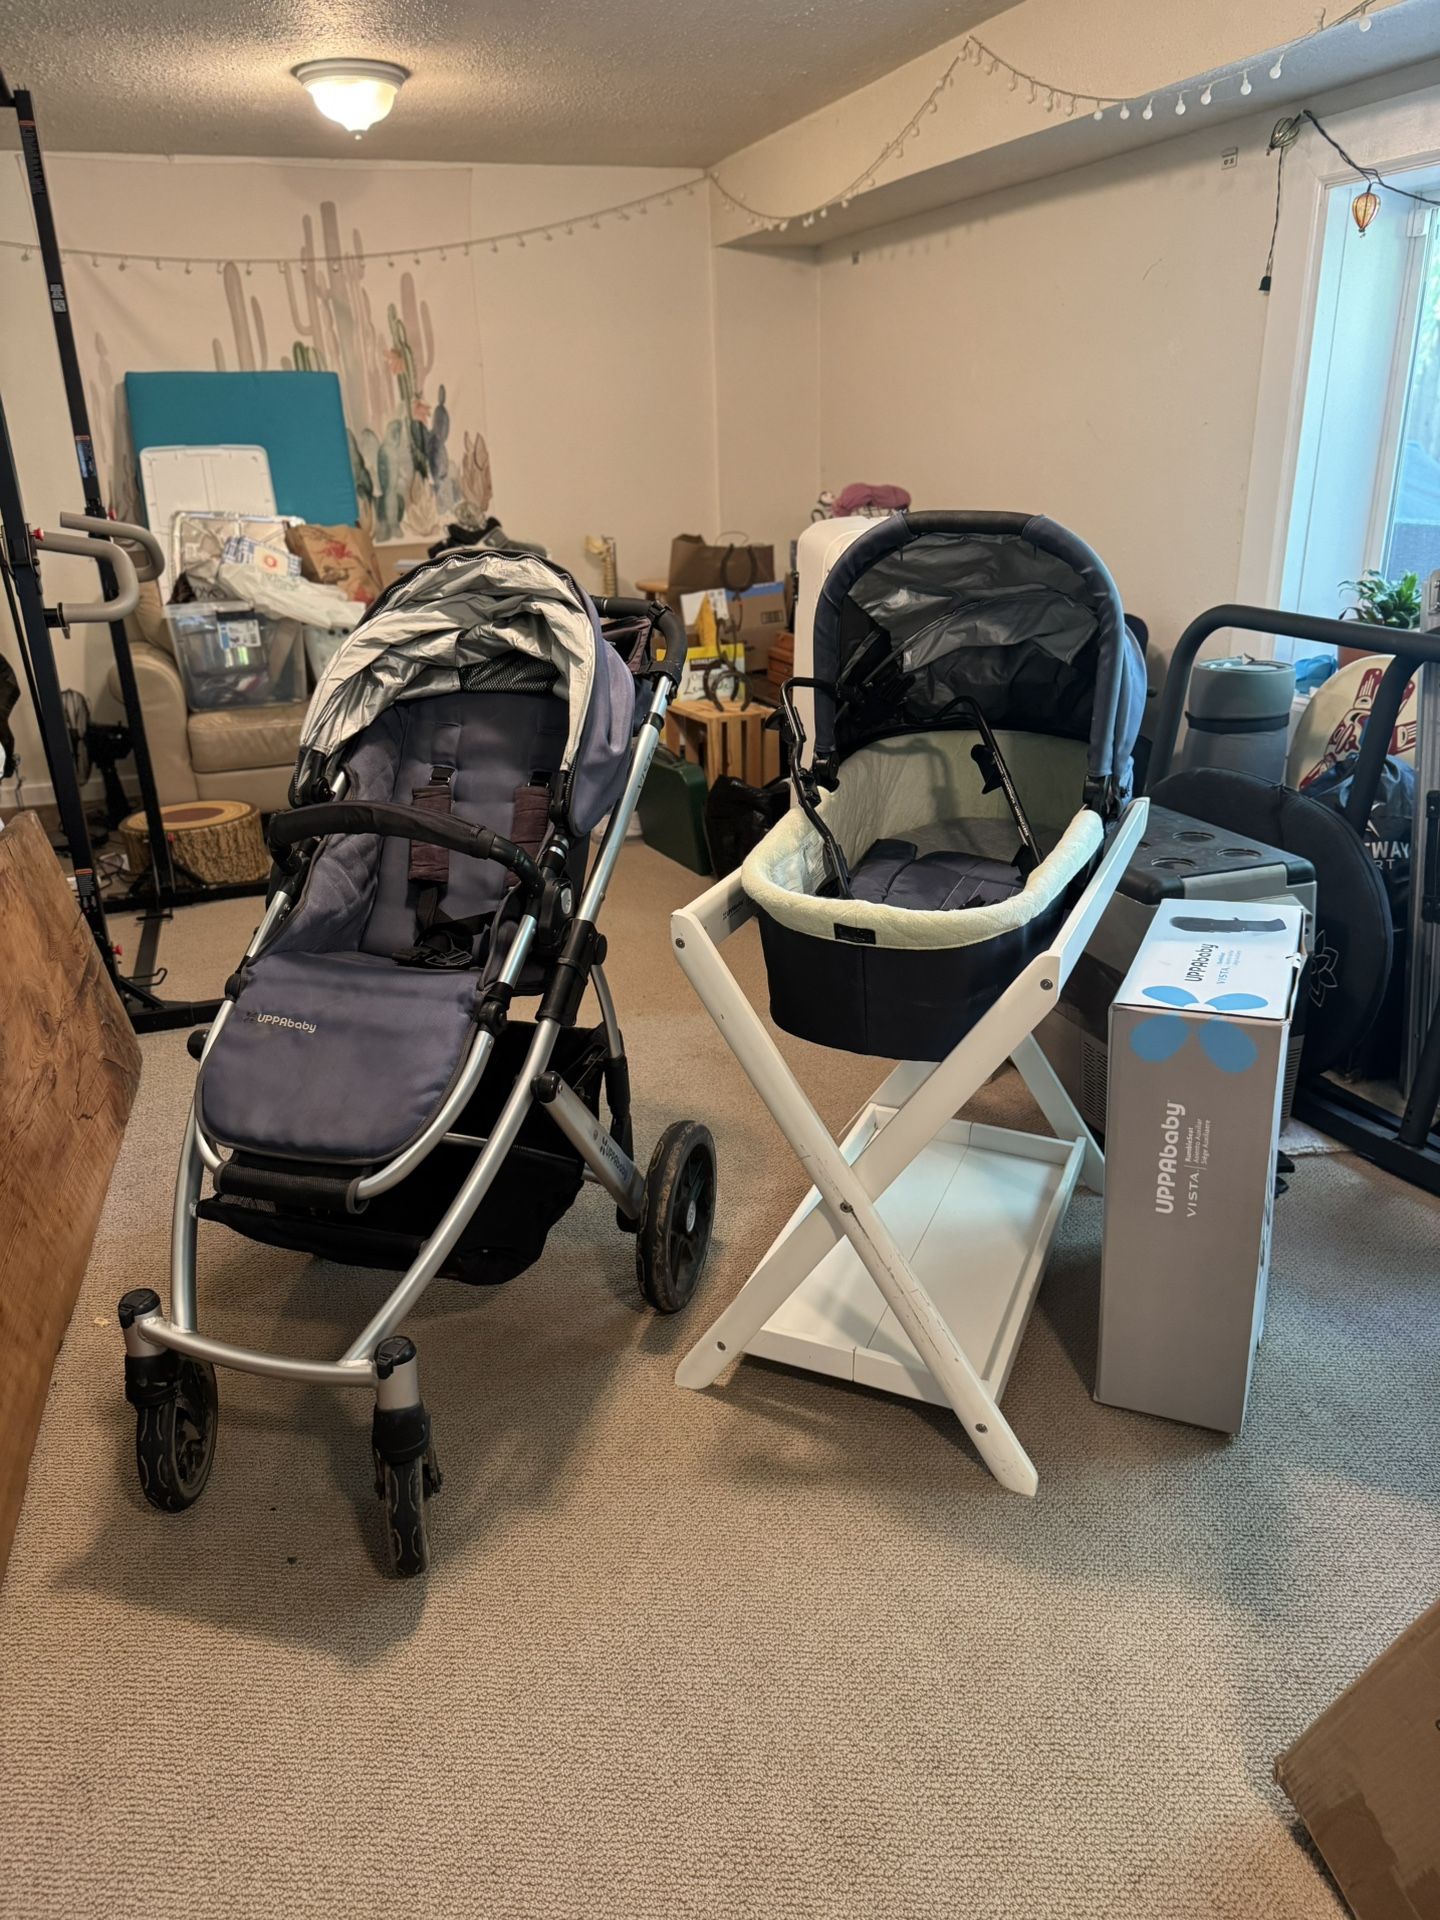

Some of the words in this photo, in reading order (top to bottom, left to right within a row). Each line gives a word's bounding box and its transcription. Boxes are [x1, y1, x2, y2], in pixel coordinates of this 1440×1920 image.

[1364, 841, 1409, 858] WAY
[1185, 943, 1219, 982] UPPAbaby
[1216, 967, 1230, 985] VISTA
[257, 1013, 317, 1034] UPPAbaby
[1155, 1101, 1186, 1214] UPPAbaby
[1186, 1171, 1200, 1217] VISTA
